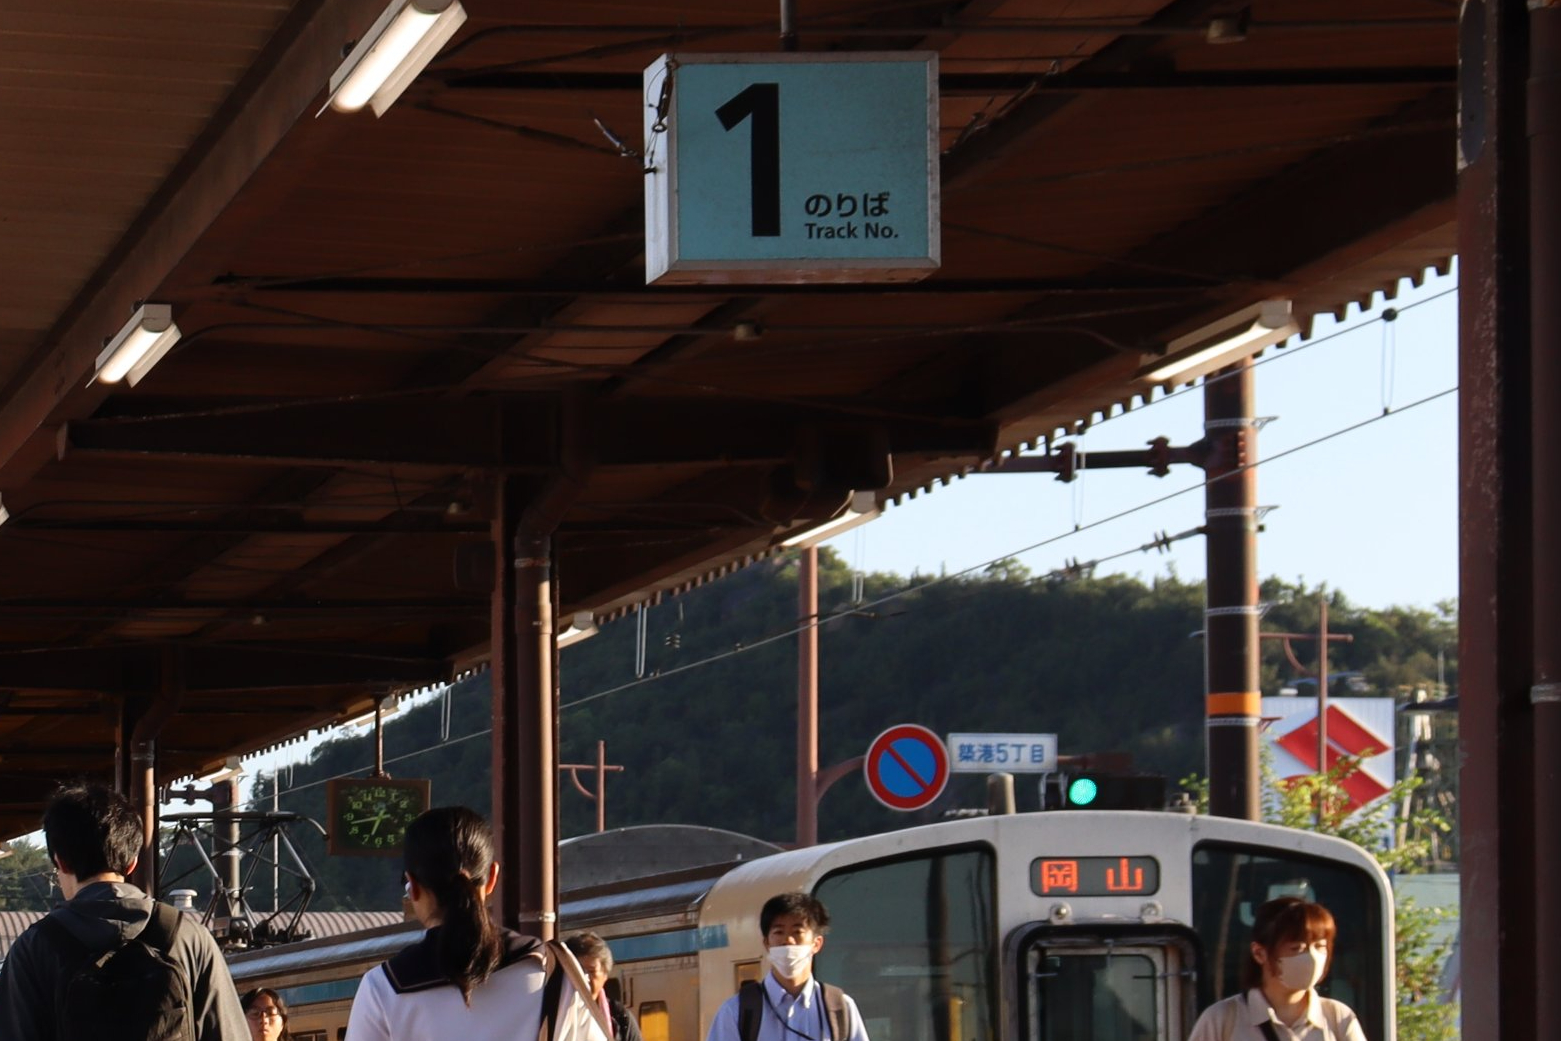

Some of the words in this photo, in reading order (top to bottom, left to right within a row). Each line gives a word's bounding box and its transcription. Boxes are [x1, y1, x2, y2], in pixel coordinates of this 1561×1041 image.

[714, 83, 781, 237] 1
[804, 191, 890, 218] のりば
[804, 222, 858, 239] Track
[864, 222, 900, 239] No.
[957, 743, 1045, 764] 築港5丁目
[1041, 857, 1144, 893] 岡山
